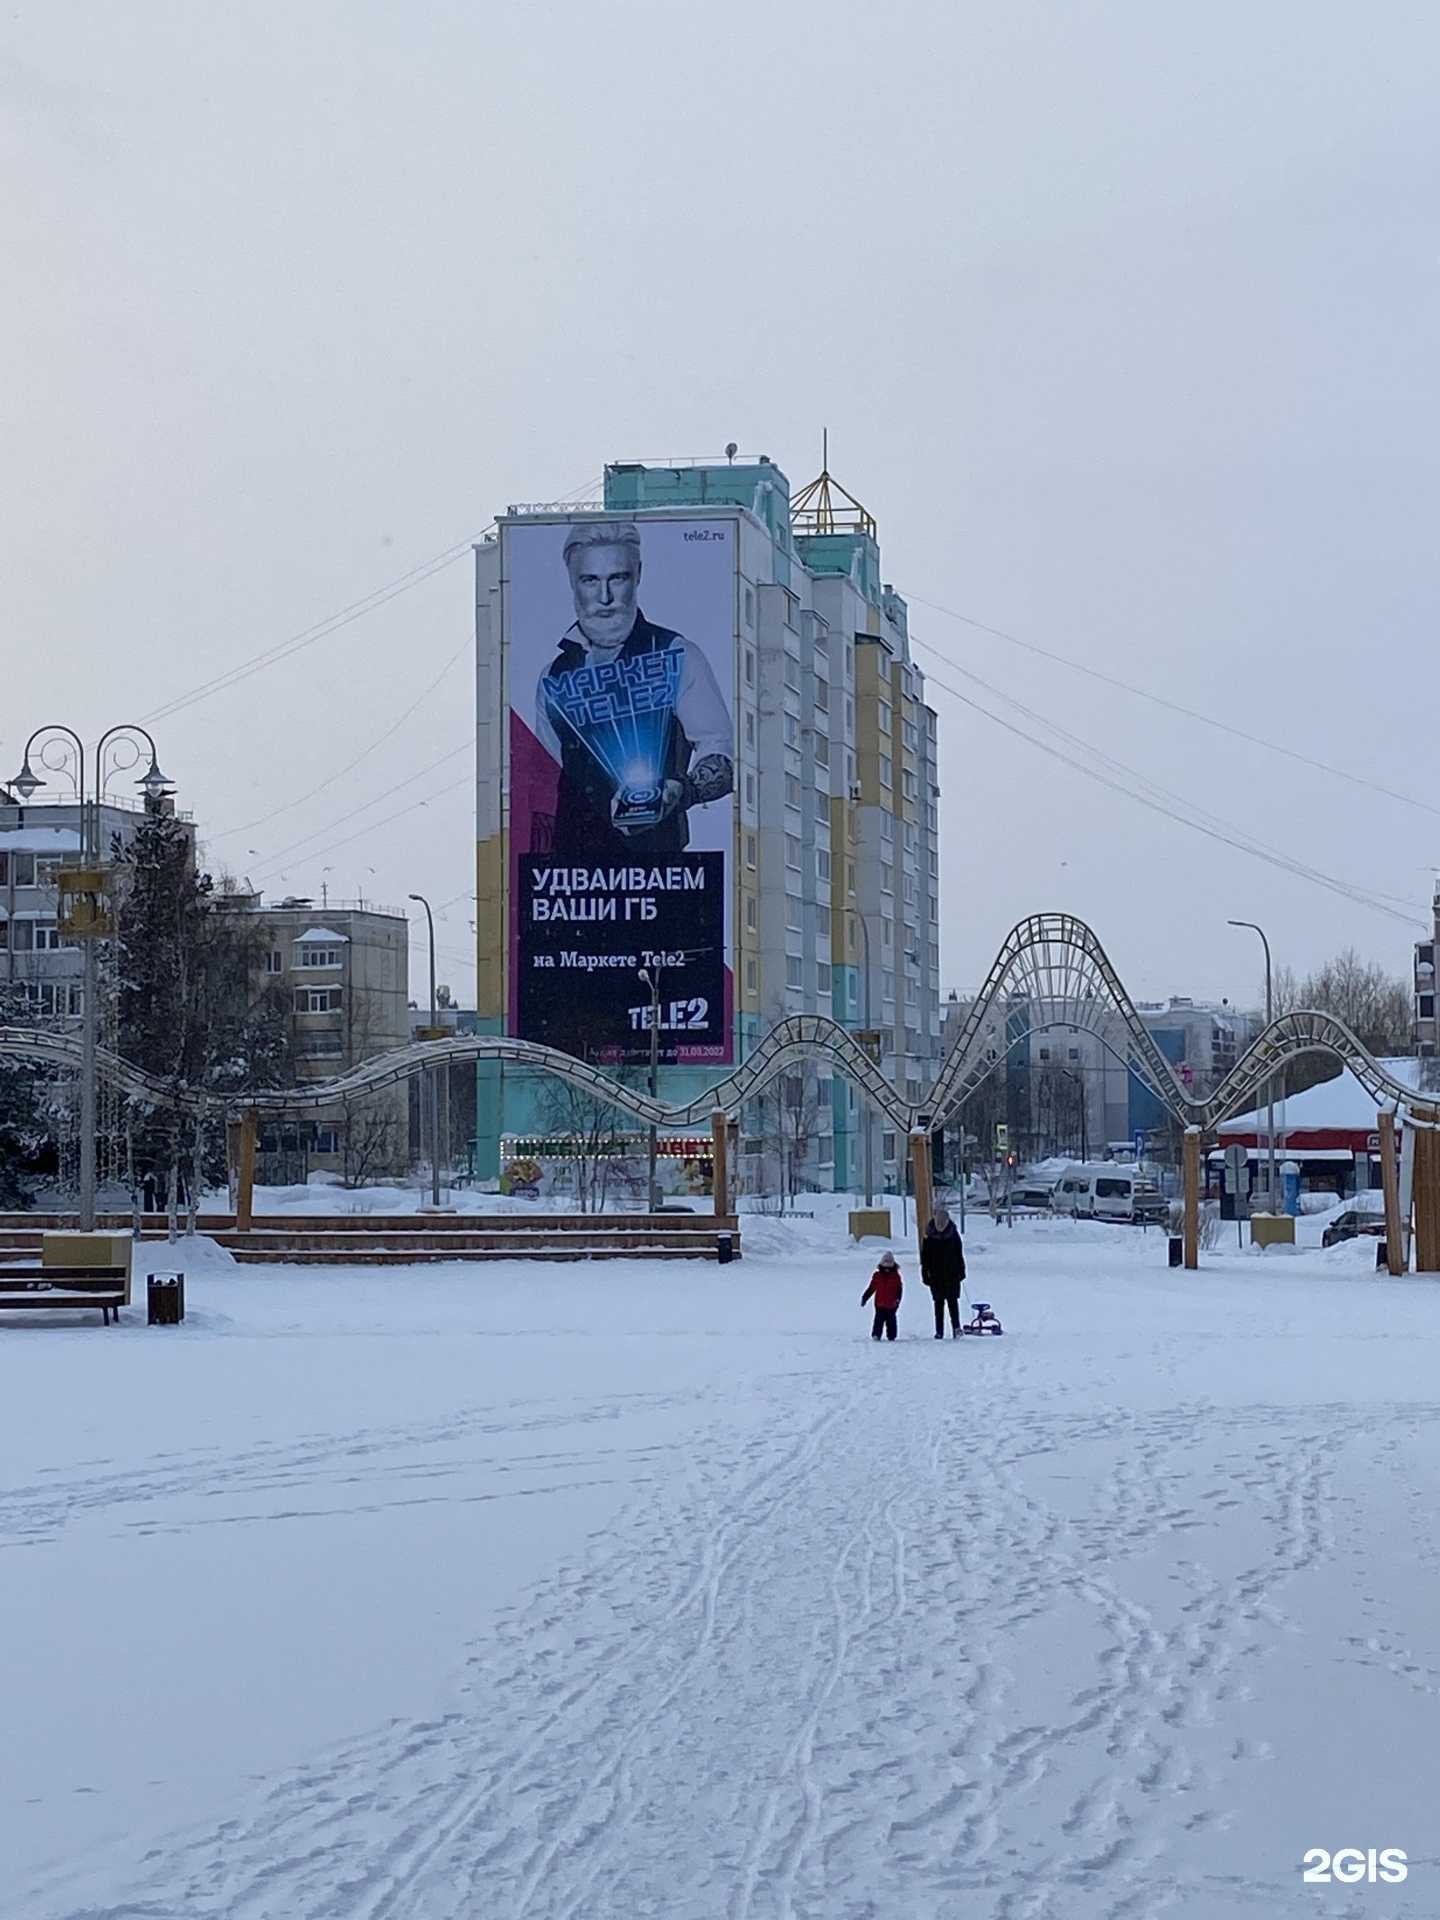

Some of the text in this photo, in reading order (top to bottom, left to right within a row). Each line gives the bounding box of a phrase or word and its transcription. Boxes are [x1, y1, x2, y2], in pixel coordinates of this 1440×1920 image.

[683, 530, 725, 541] tele2.ru
[542, 647, 686, 698] МАРКЕТ
[566, 683, 674, 727] TELE2
[532, 867, 705, 896] УДВАИВАЕМ
[532, 898, 658, 921] ВАШИ ГБ
[533, 950, 686, 972] на Маркете Tele2
[628, 997, 709, 1031] TELE2
[655, 1141, 714, 1155] ЦВЕТ
